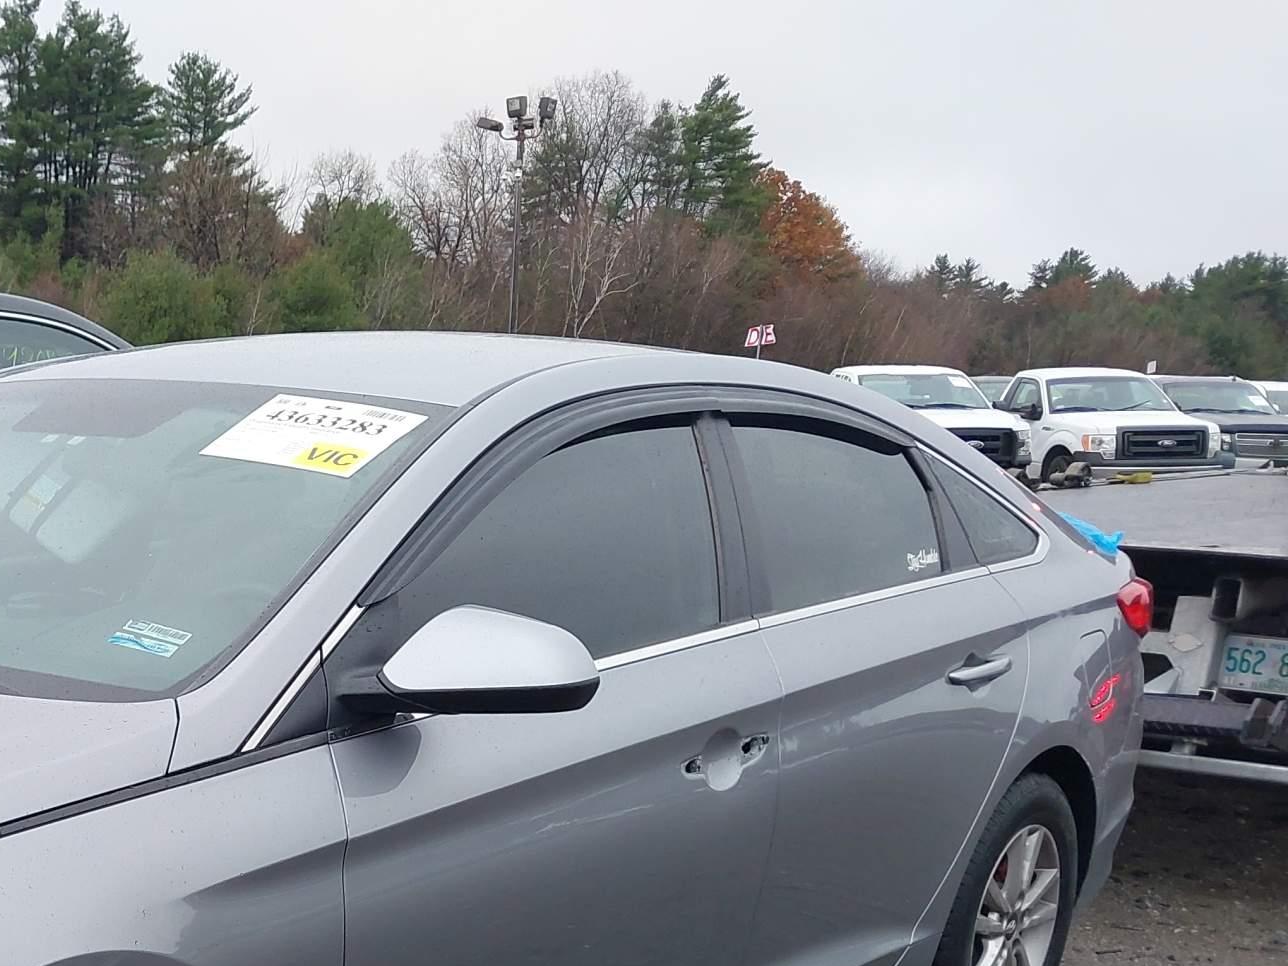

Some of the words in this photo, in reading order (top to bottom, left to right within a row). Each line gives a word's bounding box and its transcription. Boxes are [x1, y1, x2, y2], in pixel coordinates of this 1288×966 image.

[266, 409, 388, 436] 43633283
[307, 447, 359, 466] VIC
[1224, 646, 1267, 676] 562
